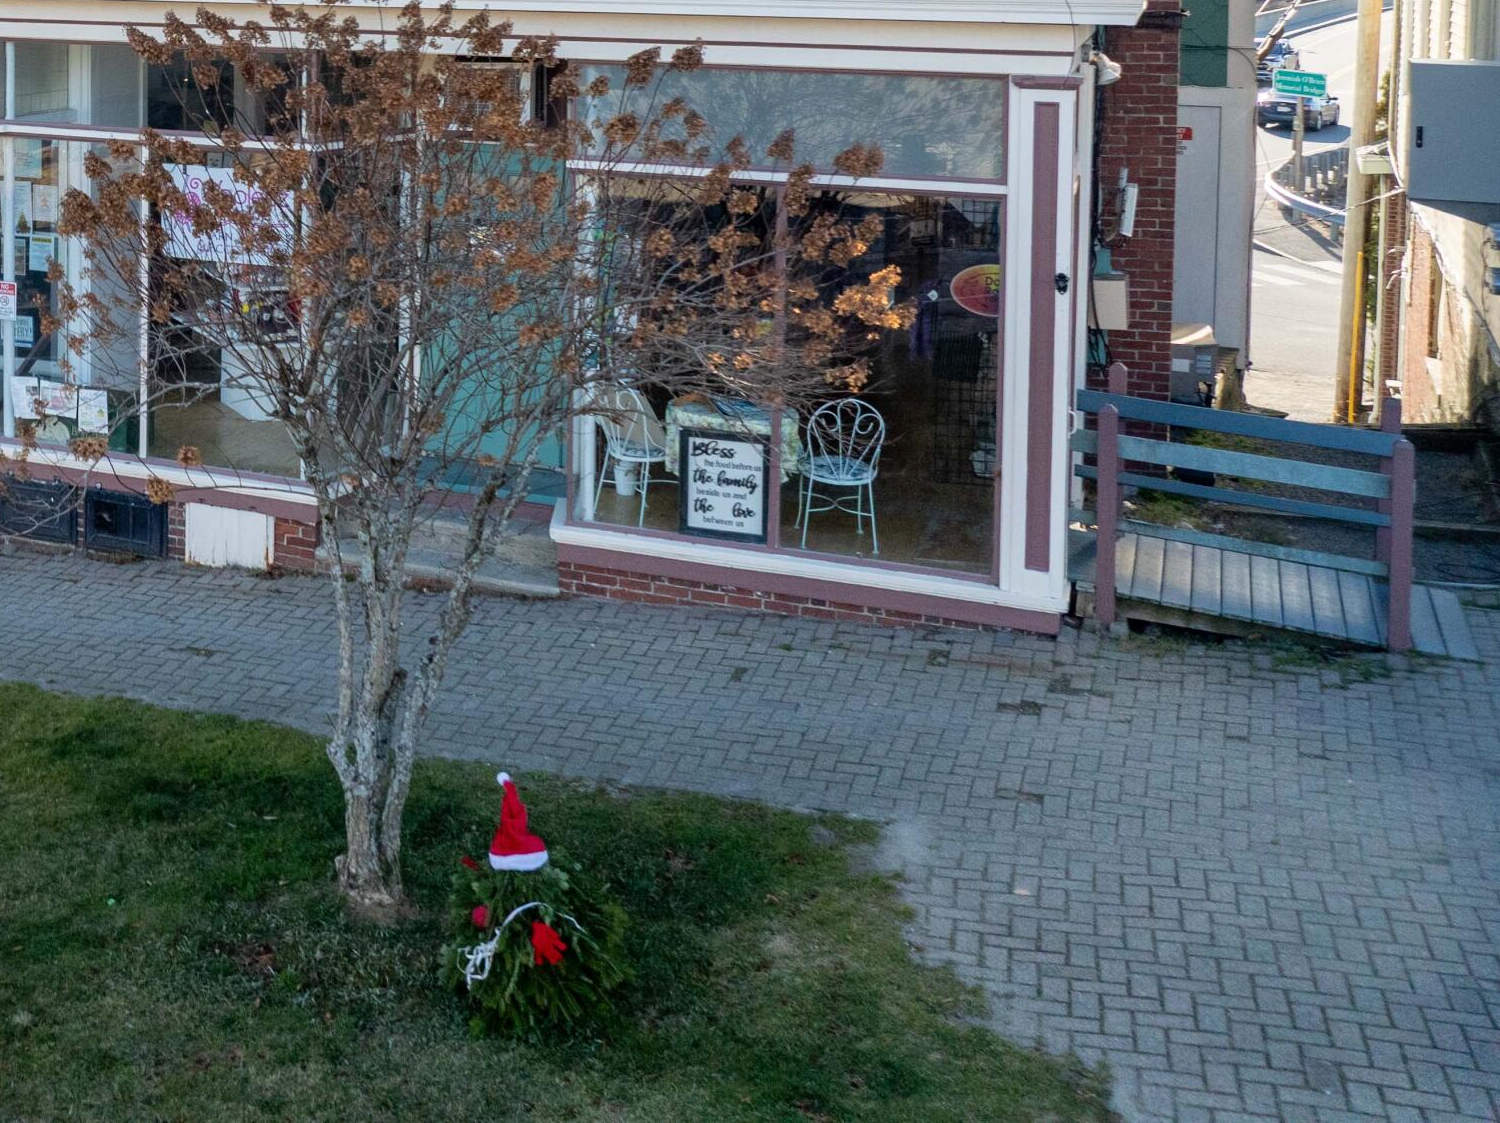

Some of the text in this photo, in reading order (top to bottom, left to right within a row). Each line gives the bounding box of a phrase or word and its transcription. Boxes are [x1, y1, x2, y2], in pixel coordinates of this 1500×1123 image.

[690, 441, 736, 458] Bless
[716, 460, 730, 469] food
[731, 461, 753, 471] before
[754, 464, 762, 472] us
[693, 467, 758, 495] the family
[696, 488, 719, 496] beside
[733, 492, 747, 500] and
[693, 497, 756, 518] the love
[703, 516, 733, 526] between
